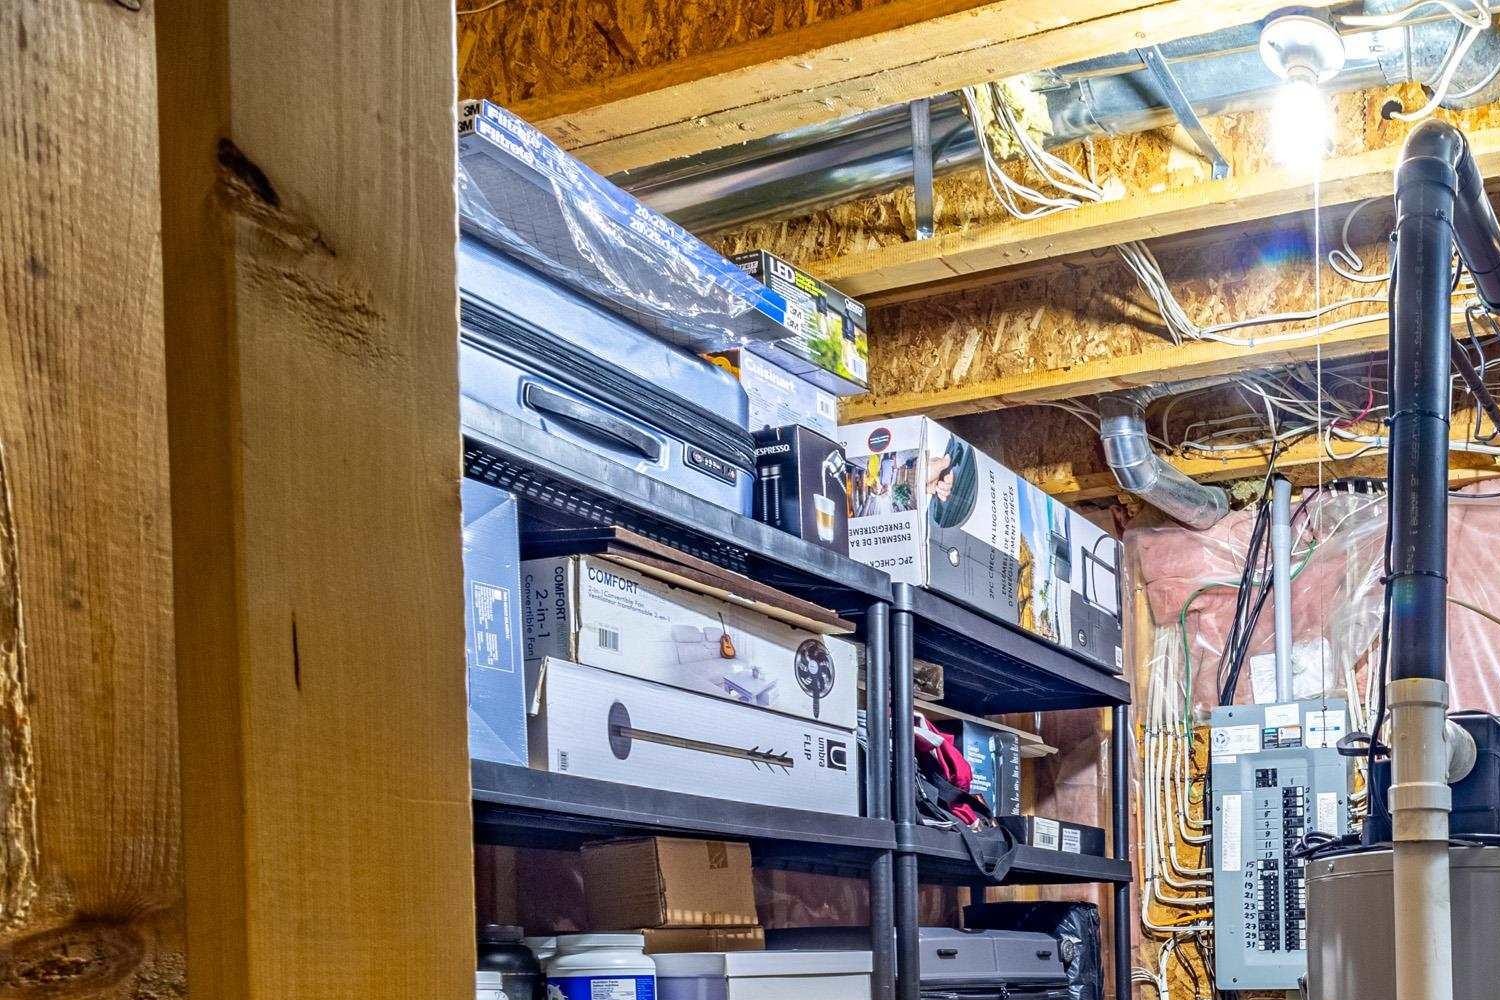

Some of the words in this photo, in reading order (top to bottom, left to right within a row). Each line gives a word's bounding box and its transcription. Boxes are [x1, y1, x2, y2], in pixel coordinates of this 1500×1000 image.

[464, 104, 480, 116] 3M
[770, 257, 795, 284] LED
[1002, 492, 1010, 536] BAGAGES
[862, 538, 872, 546] DE
[874, 533, 911, 546] ENSEMBLE
[898, 556, 913, 566] 2PC
[554, 566, 566, 621] COMFORT
[588, 568, 639, 594] COMFORT
[524, 575, 536, 638] Convertible
[536, 589, 550, 639] 2-in-1
[527, 637, 536, 656] Fan
